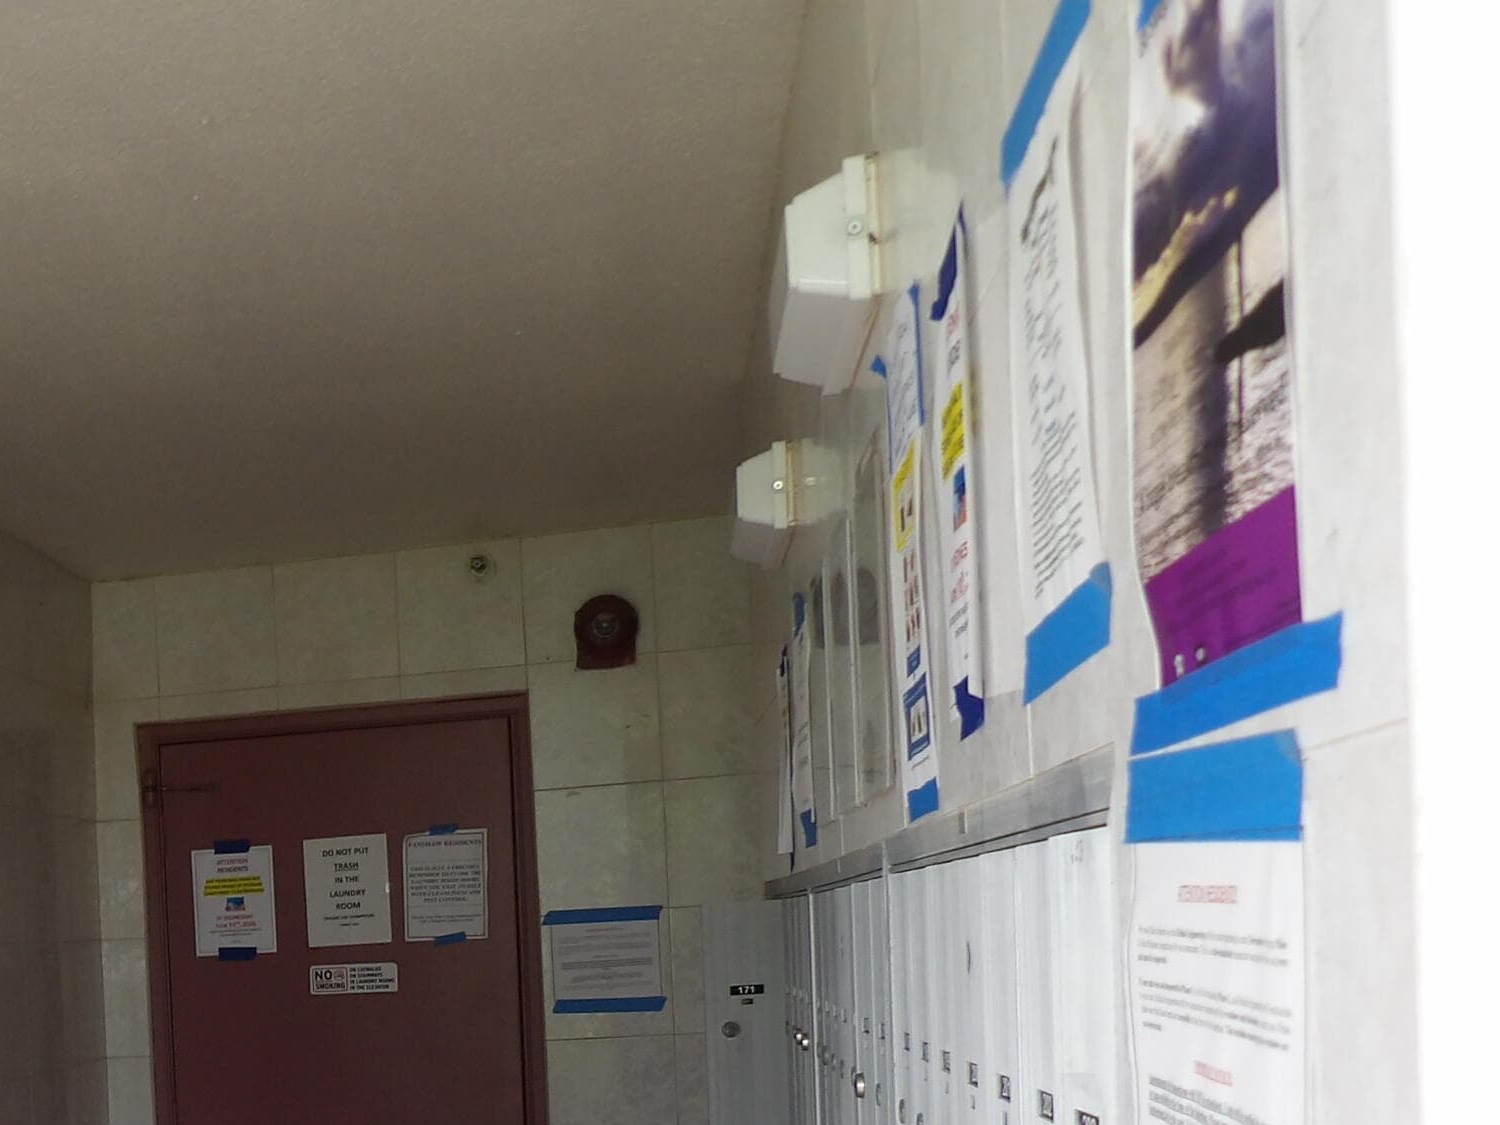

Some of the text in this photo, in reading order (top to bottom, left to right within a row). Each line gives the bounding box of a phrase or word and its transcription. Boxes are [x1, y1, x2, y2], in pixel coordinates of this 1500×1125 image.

[322, 847, 369, 858] DO NOT PUT
[334, 862, 359, 870] TRASH
[345, 875, 359, 883] THE
[330, 889, 366, 898] LAUNDRY
[336, 902, 361, 910] ROOM
[315, 970, 332, 981] NO
[737, 985, 755, 994] 171
